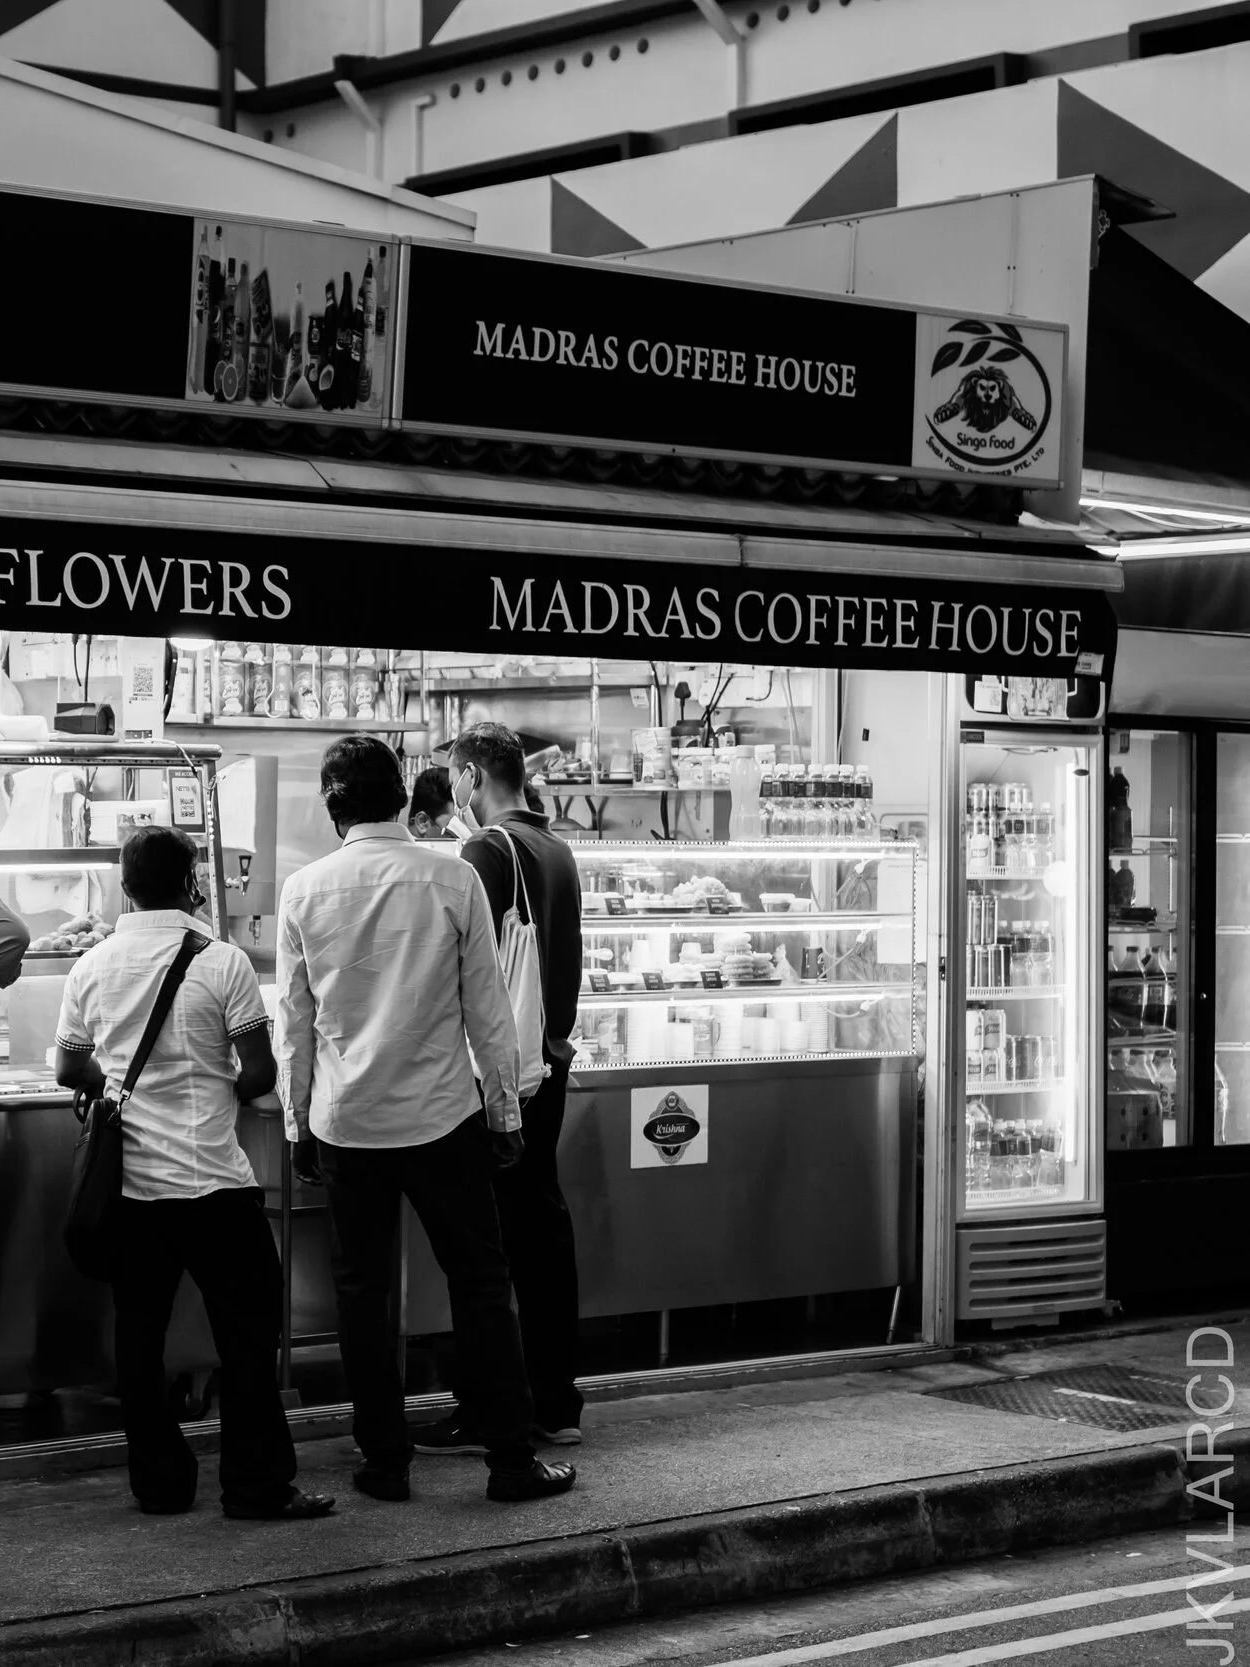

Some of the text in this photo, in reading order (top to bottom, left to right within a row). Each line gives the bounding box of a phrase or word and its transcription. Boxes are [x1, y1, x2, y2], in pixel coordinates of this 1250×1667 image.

[473, 320, 857, 398] MADRAS COFFEE HOUSE
[956, 431, 987, 451] Singa
[488, 576, 1082, 658] MADRAS COFFEE HOUSE
